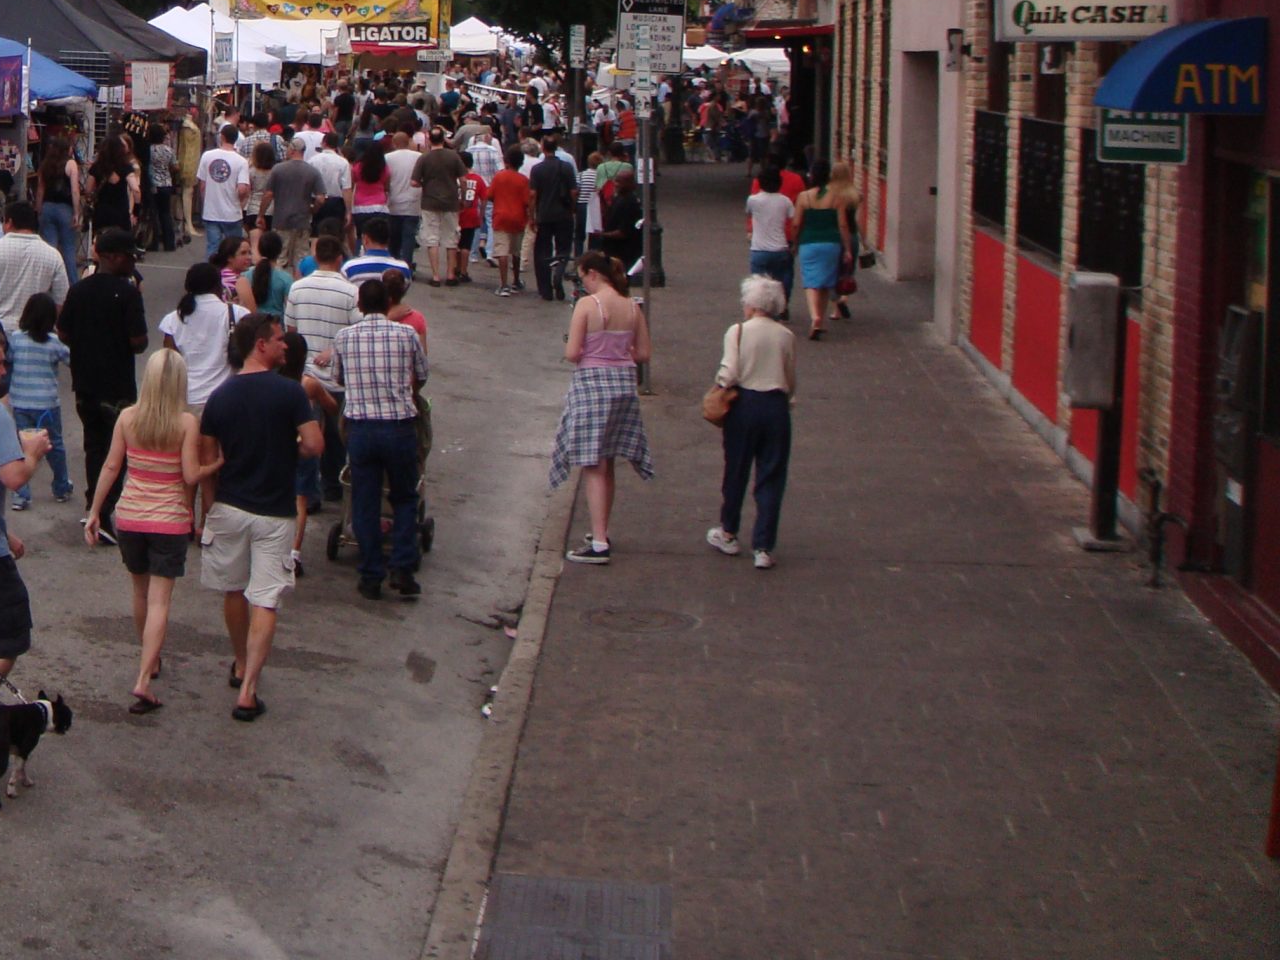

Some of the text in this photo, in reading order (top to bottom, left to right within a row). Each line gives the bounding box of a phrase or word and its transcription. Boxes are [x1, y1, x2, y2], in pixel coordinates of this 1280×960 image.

[1013, 0, 1067, 35] Quik
[1072, 5, 1147, 24] CASH
[1175, 64, 1260, 105] ATM
[1109, 129, 1176, 144] MACHINE
